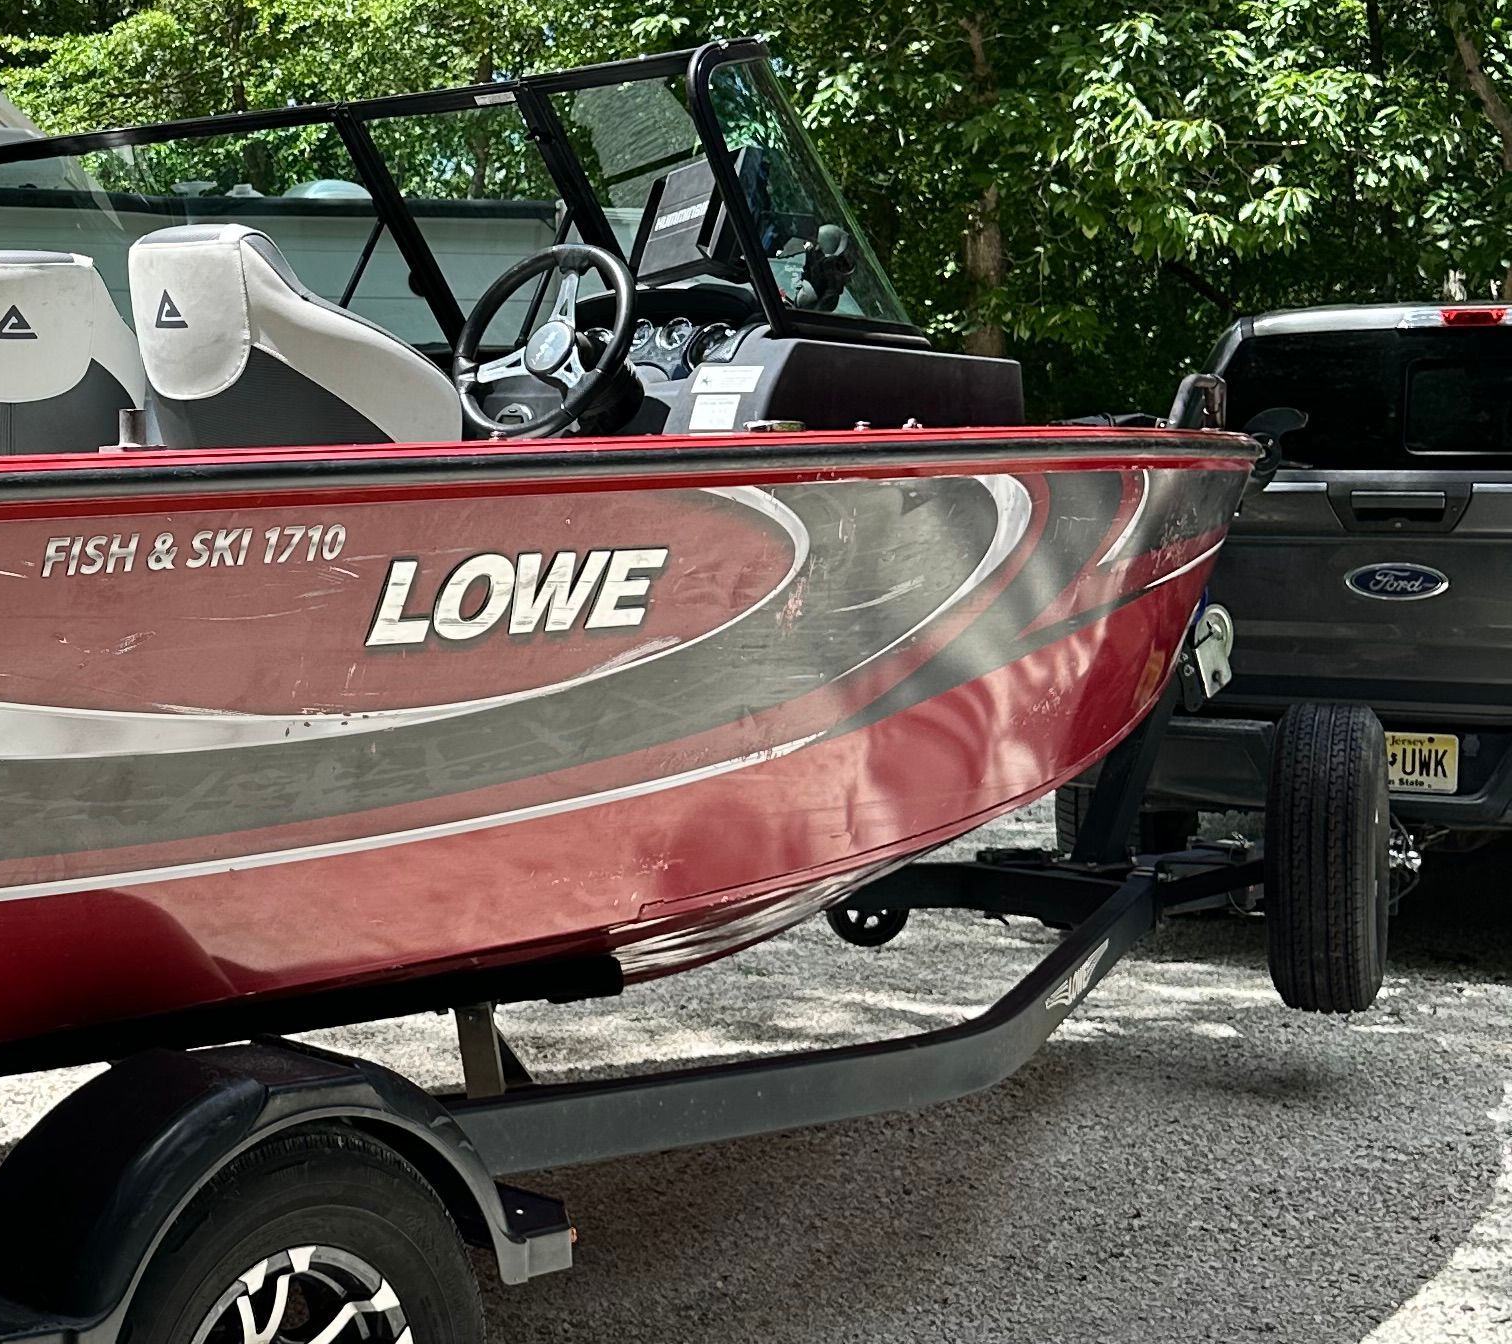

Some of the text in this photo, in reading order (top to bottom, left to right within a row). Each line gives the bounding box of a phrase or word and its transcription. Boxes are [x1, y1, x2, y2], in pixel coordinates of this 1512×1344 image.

[40, 523, 347, 578] FISH & SKI 1710
[1369, 569, 1429, 592] Ford
[364, 548, 669, 646] LOWE
[1389, 736, 1426, 747] Jersey
[1401, 747, 1449, 778] UWK
